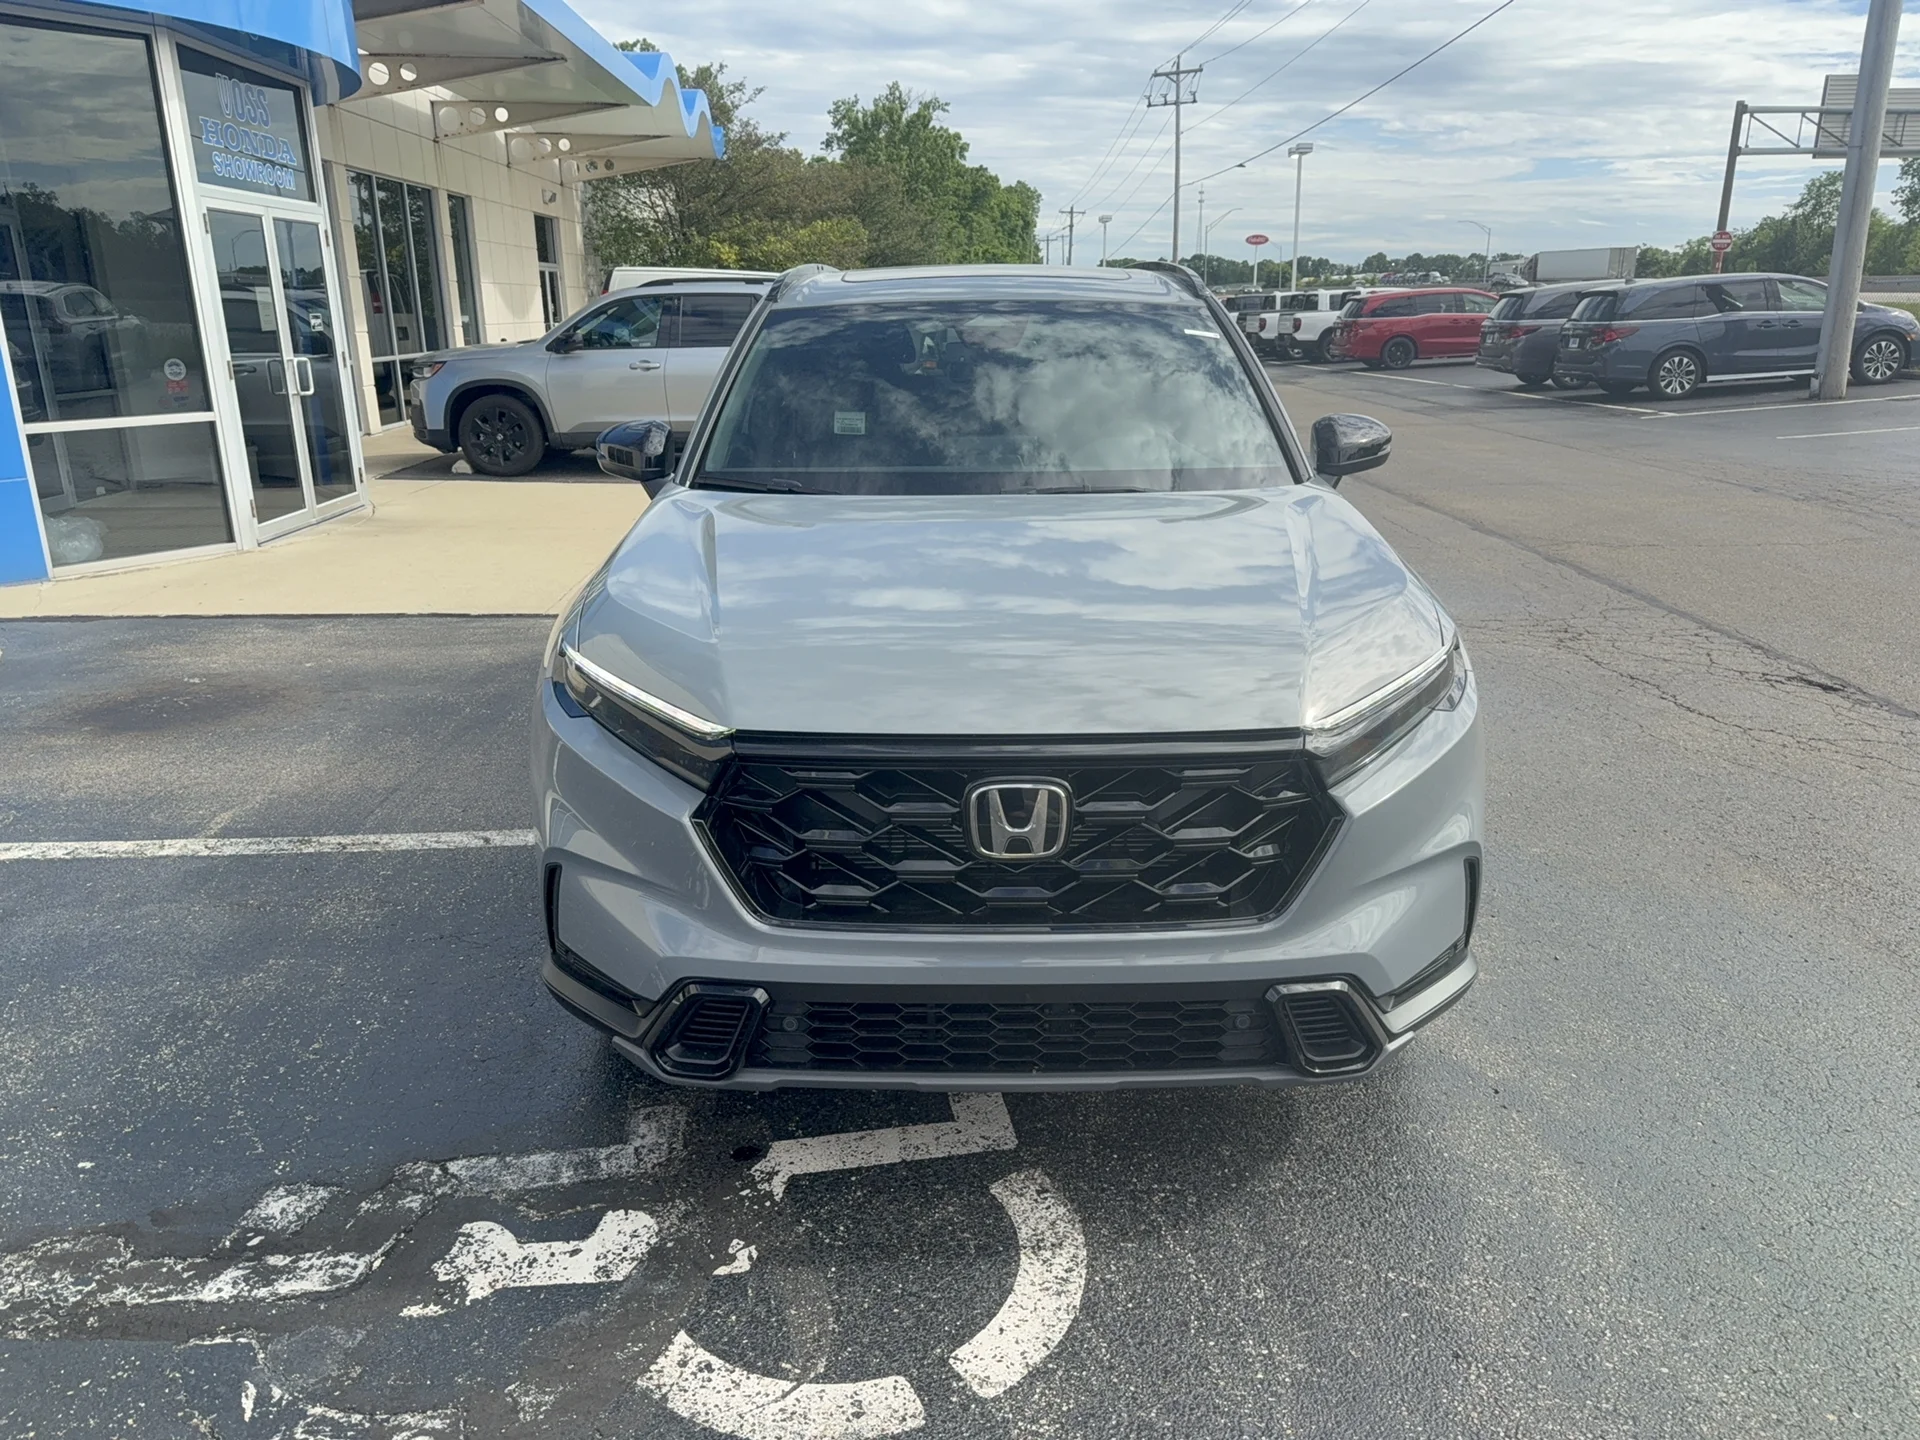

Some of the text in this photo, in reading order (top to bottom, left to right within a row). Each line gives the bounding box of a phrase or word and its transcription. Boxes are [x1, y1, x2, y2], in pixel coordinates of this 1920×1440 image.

[216, 73, 271, 128] VOSS
[199, 116, 297, 165] HONDA
[212, 151, 296, 190] SHOWROOM
